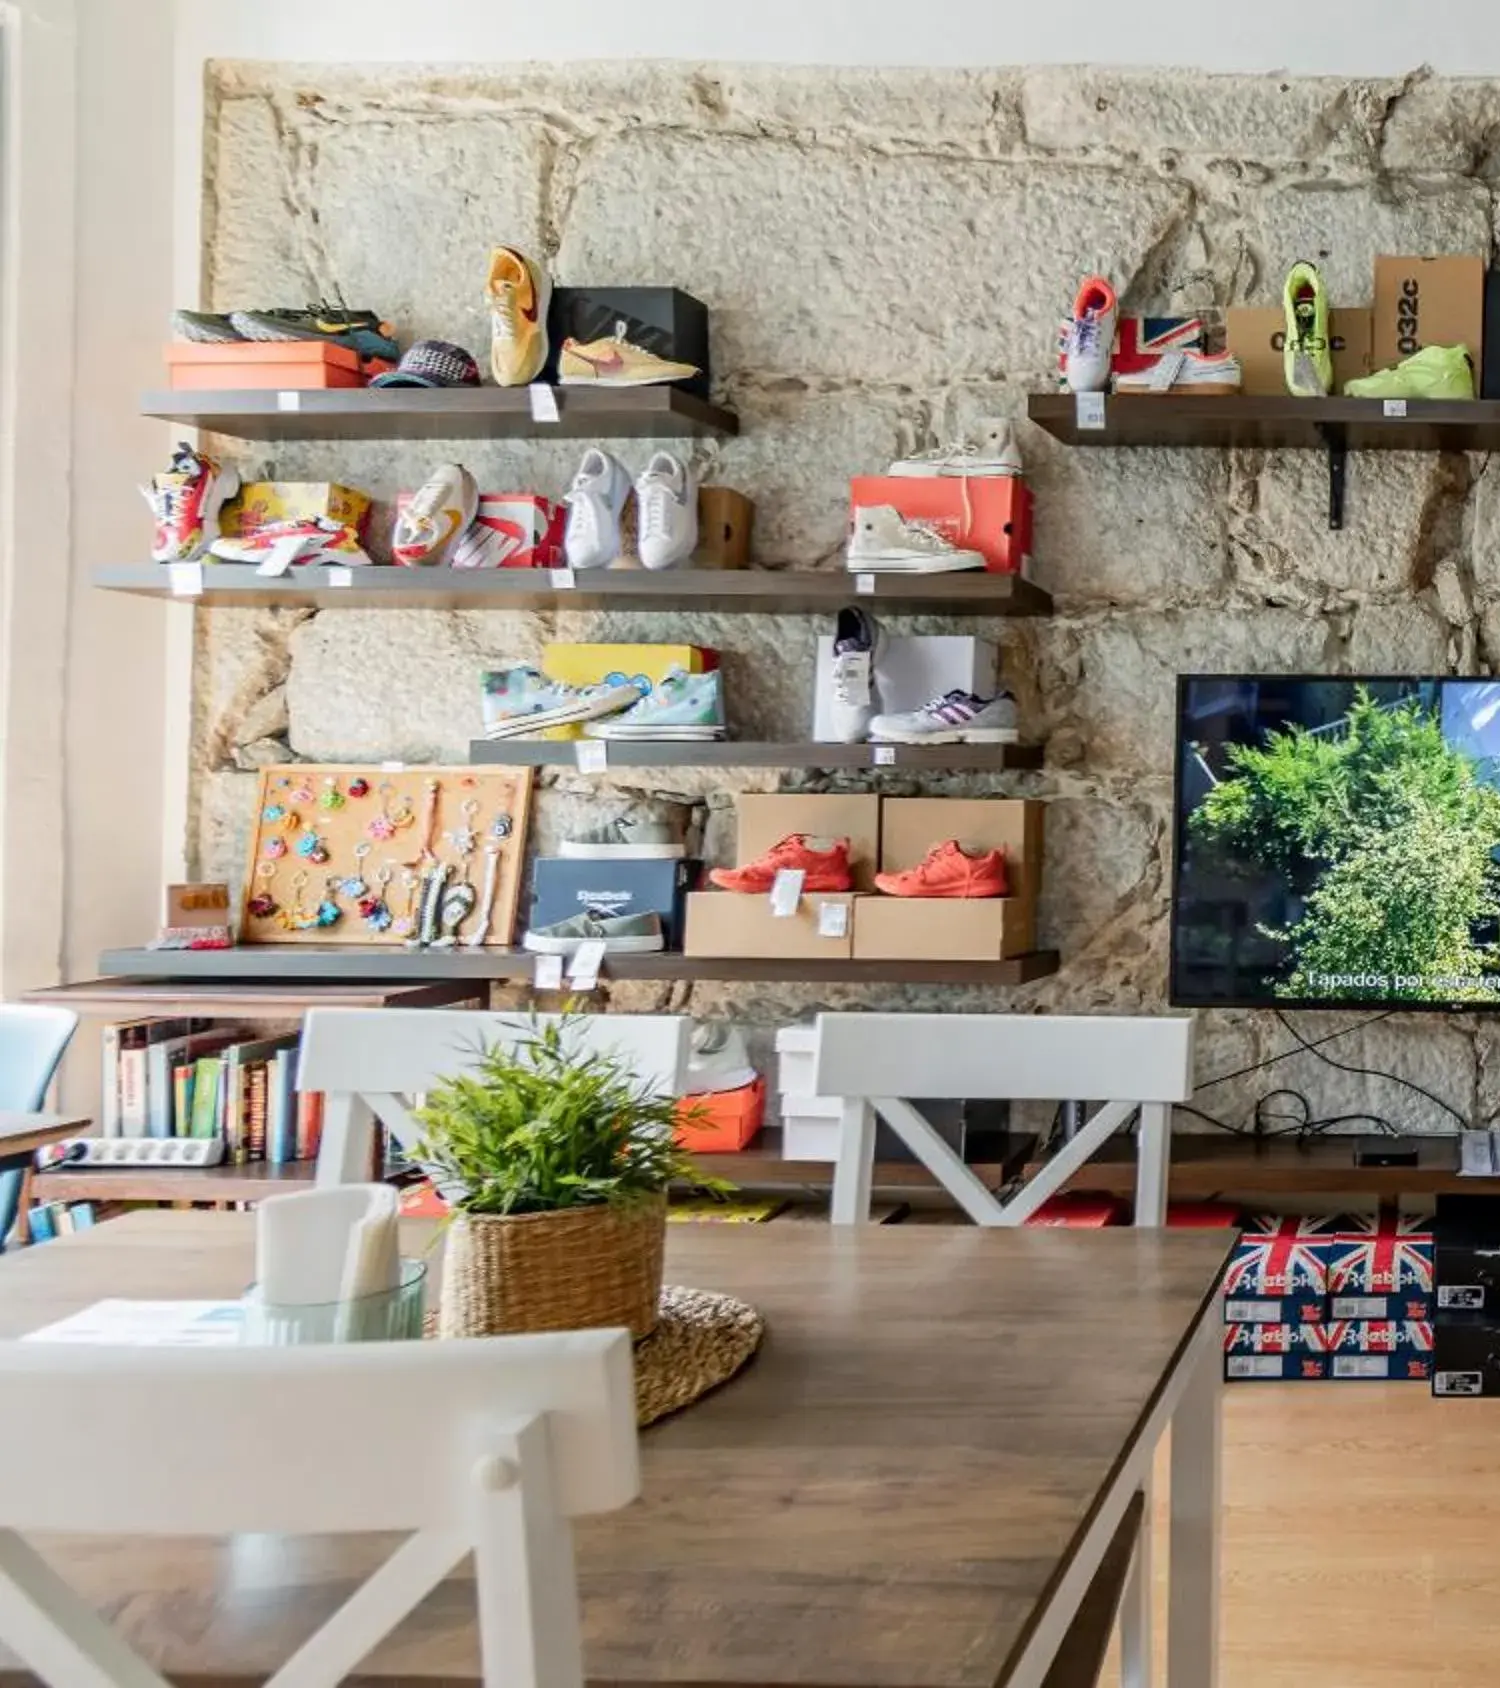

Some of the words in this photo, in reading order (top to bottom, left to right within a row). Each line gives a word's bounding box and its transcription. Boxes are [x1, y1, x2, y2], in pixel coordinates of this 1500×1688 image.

[1397, 278, 1419, 353] 032c
[1270, 332, 1346, 352] 0c
[1309, 971, 1389, 990] Tapados
